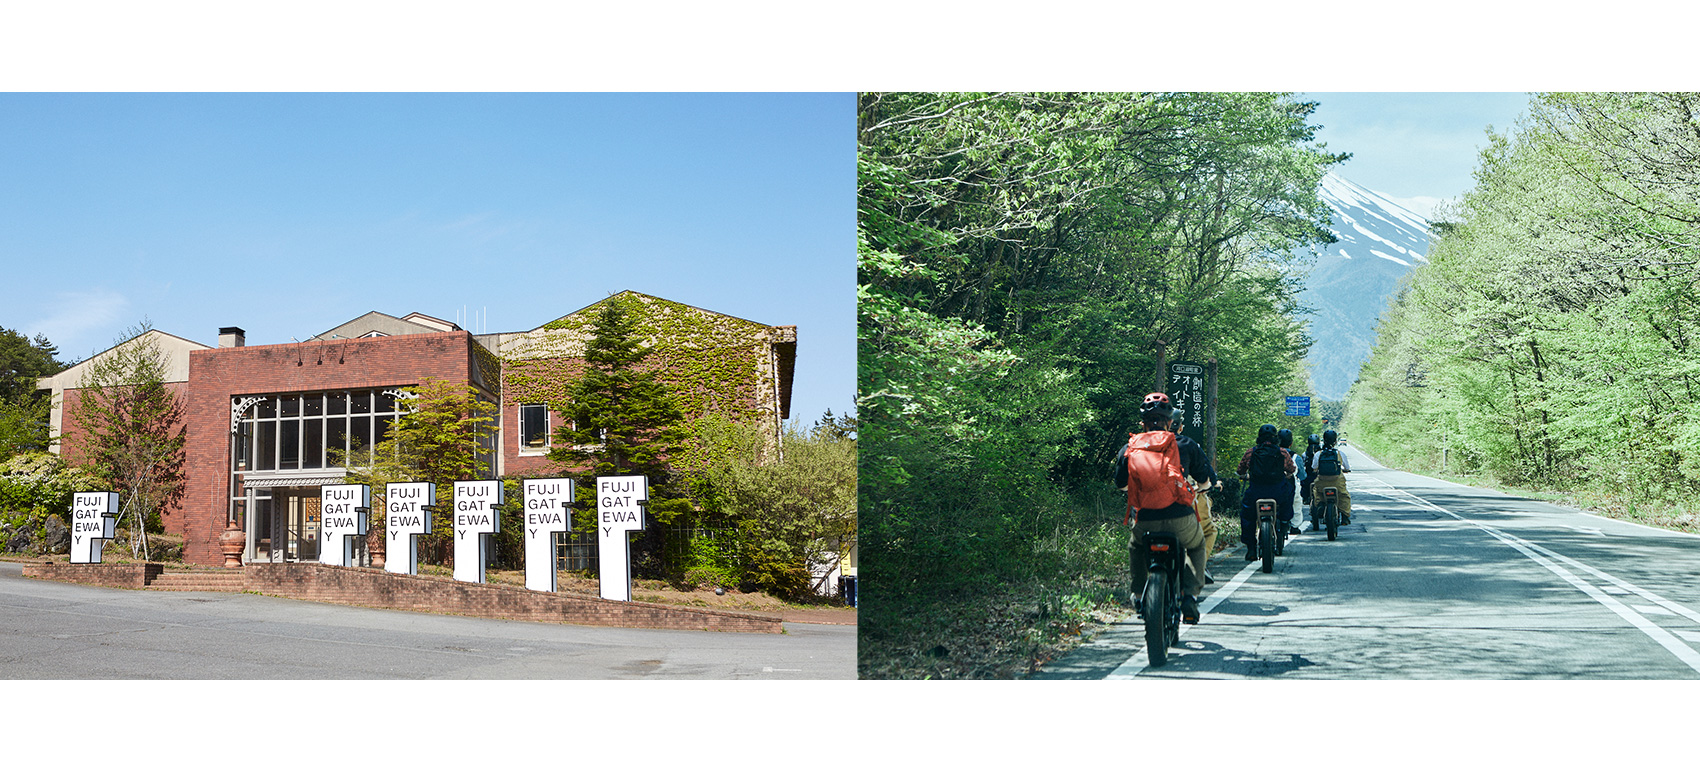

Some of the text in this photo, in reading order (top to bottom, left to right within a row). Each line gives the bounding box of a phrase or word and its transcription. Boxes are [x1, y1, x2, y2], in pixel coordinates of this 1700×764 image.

[1182, 375, 1190, 400] オート
[1192, 376, 1203, 427] 創造の森
[458, 486, 489, 497] FUJI
[528, 484, 560, 495] FUJI
[601, 481, 635, 492] FUJI
[325, 490, 354, 500] FUJI
[390, 488, 420, 498] FUJI
[76, 496, 102, 507] FUJI
[458, 501, 486, 511] GAT
[528, 499, 557, 509] GAT
[601, 496, 632, 507] GAT
[325, 504, 351, 514] GAT
[390, 502, 417, 512] GAT
[75, 509, 98, 519] GAT
[528, 513, 562, 524] EWA
[602, 511, 637, 522] EWA
[325, 518, 354, 528] EWA
[390, 516, 421, 526] EWA
[458, 515, 490, 525] EWA
[75, 522, 101, 532] EWA
[602, 526, 612, 537] Y
[325, 532, 333, 542] Y
[390, 531, 399, 541] Y
[458, 530, 467, 540] Y
[528, 529, 538, 539] Y
[75, 535, 82, 545] Y
